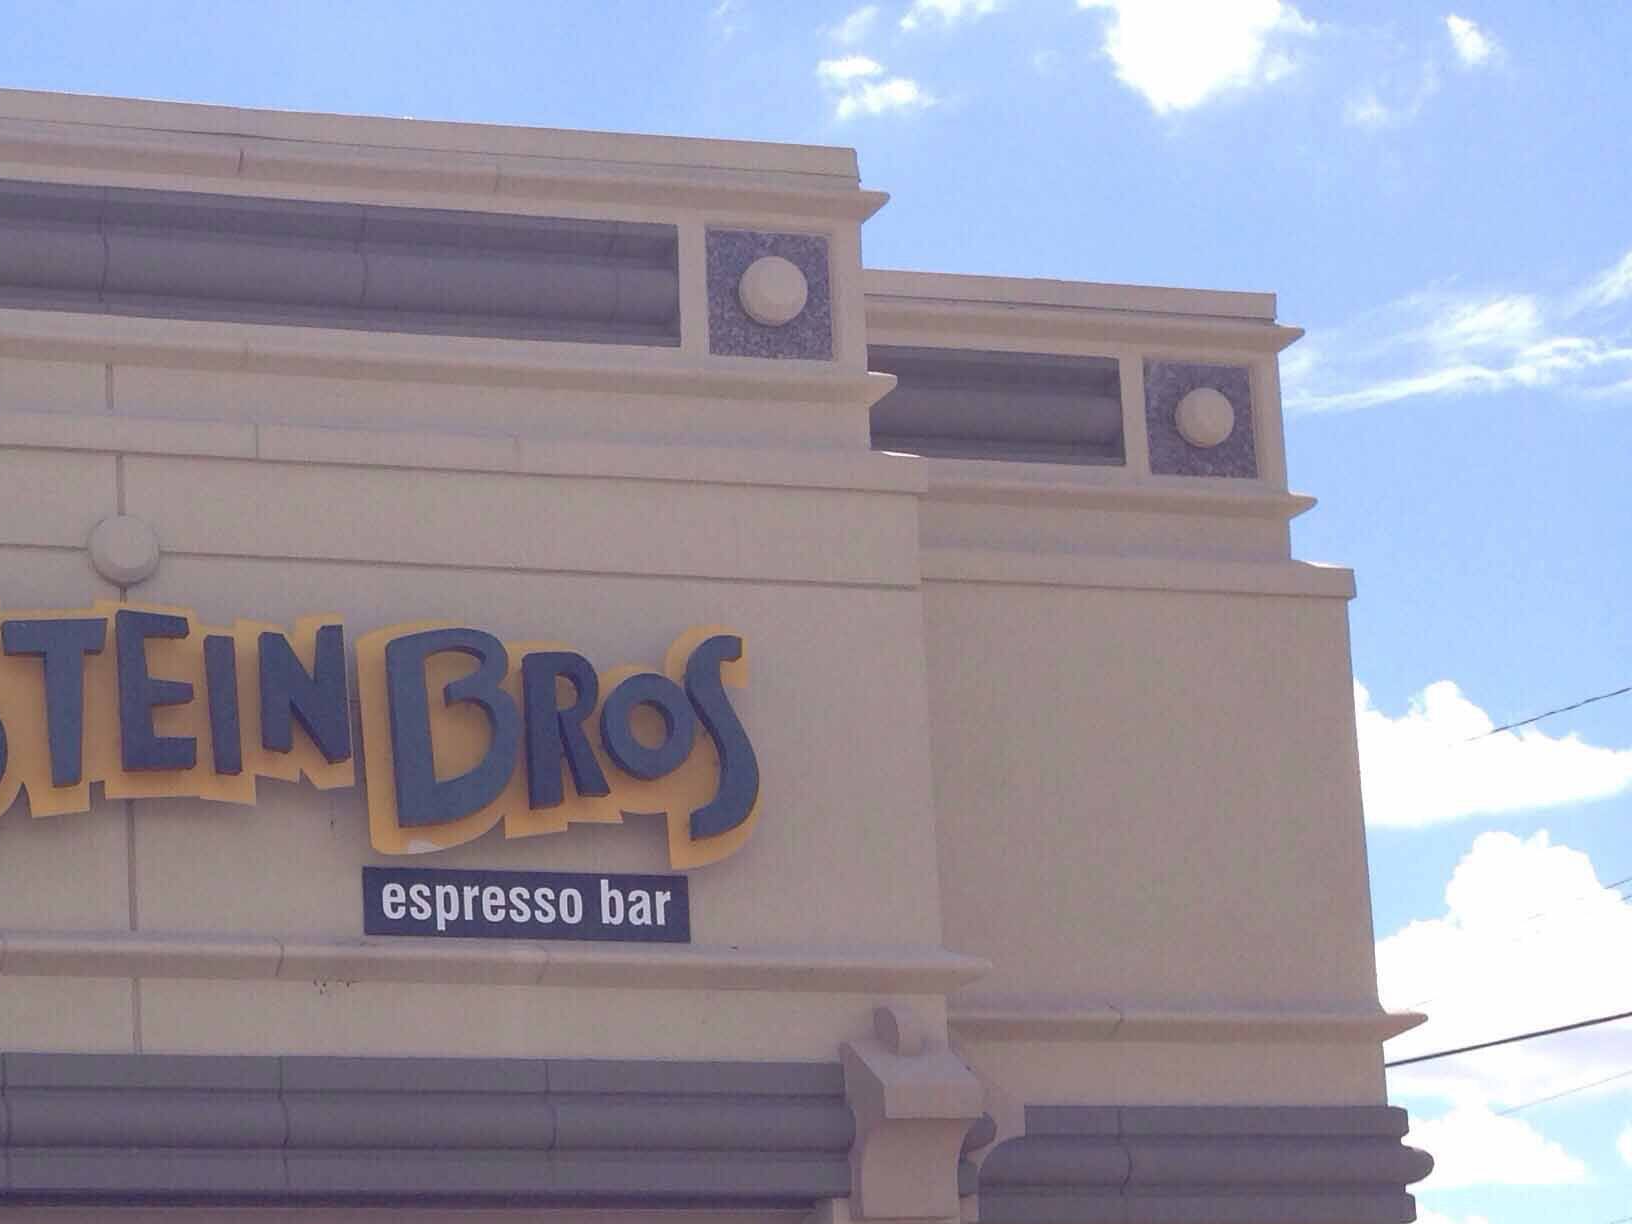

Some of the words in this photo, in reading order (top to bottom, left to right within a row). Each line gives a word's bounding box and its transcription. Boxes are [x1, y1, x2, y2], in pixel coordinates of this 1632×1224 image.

[386, 625, 761, 843] BROS
[381, 881, 583, 932] espresso
[599, 878, 671, 927] bar
